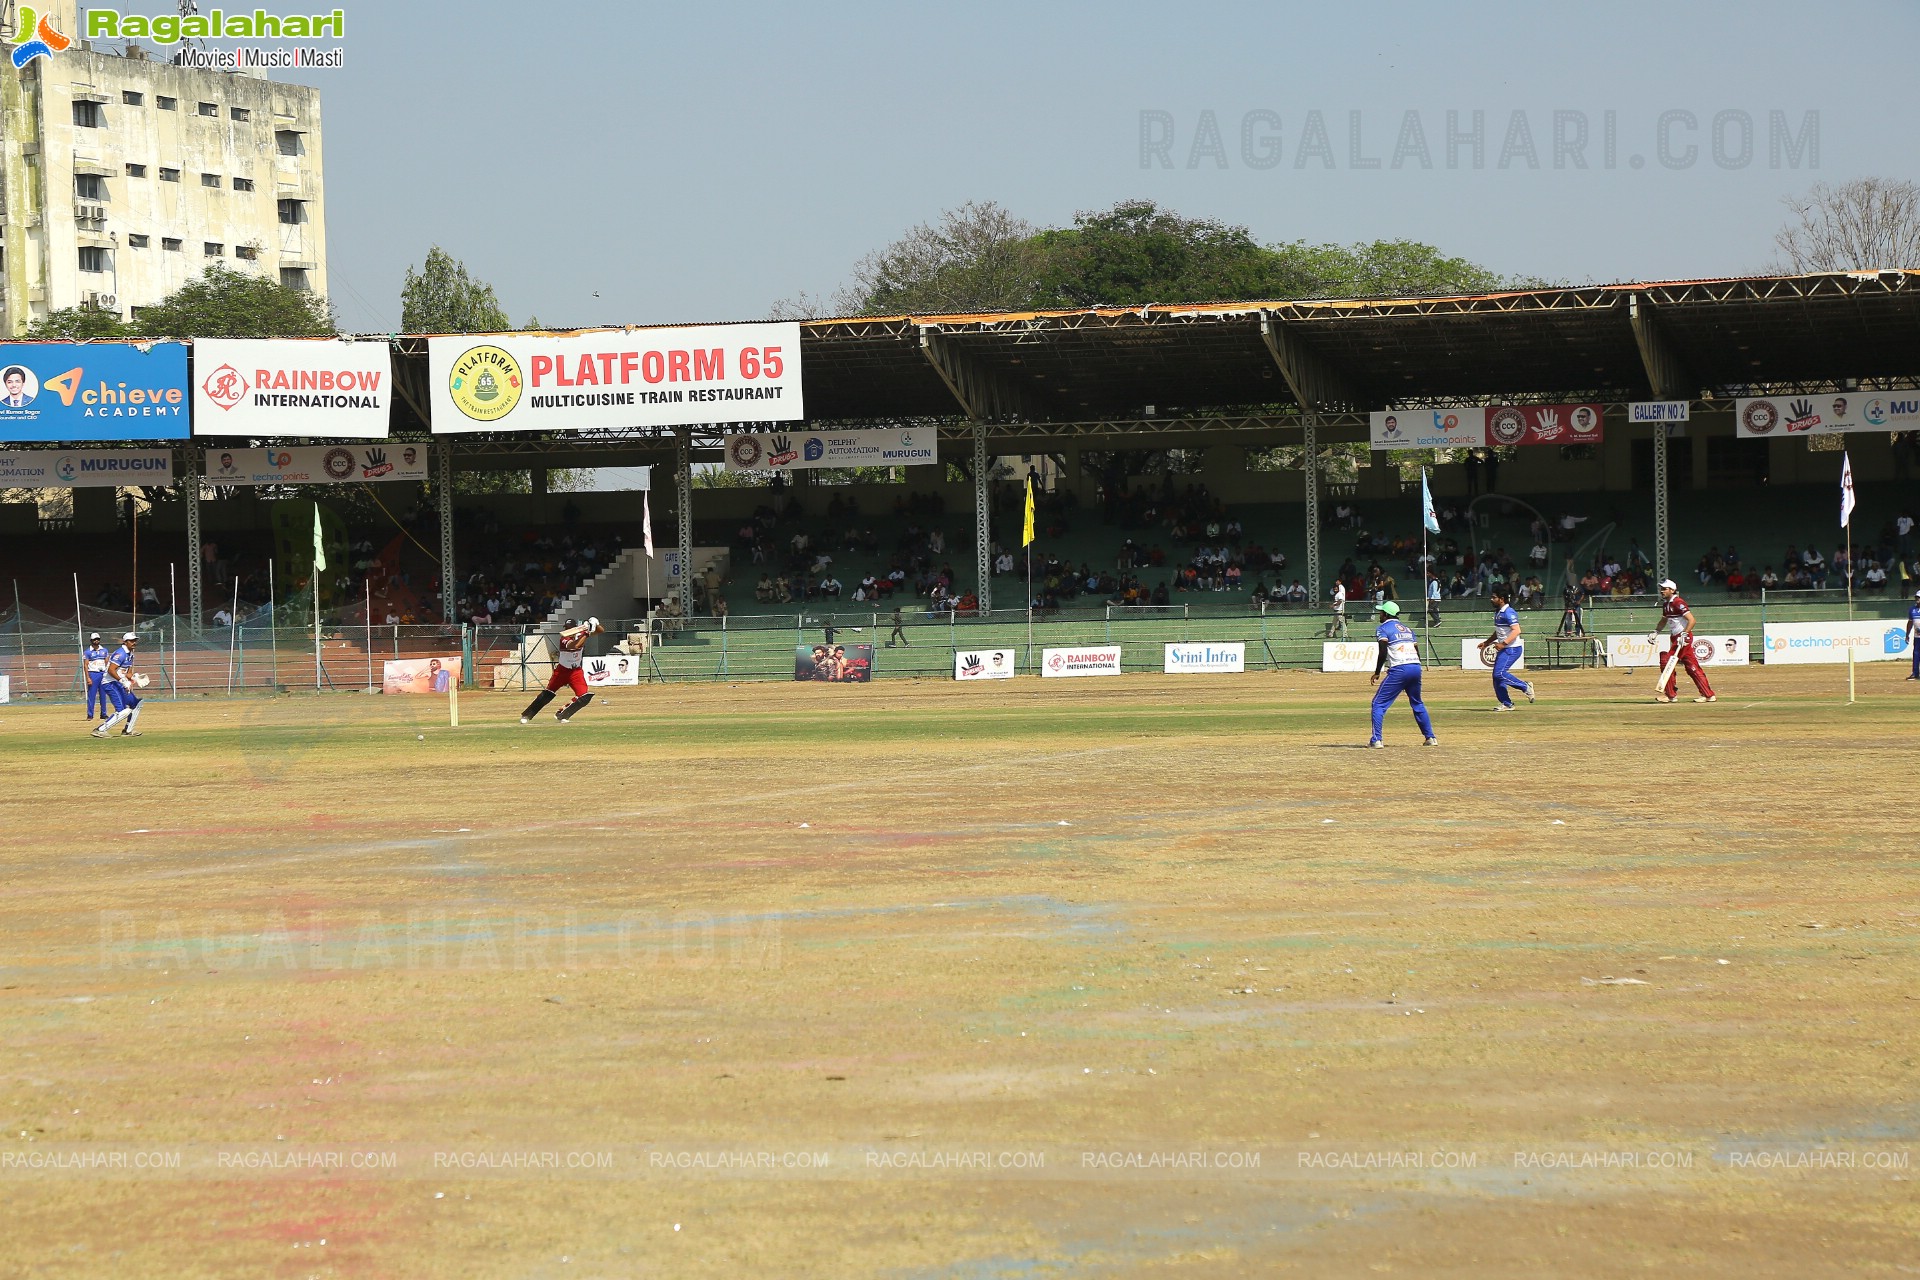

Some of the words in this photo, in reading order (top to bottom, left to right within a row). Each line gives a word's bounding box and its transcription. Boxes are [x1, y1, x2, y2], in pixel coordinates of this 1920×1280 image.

[458, 352, 514, 376] PLATFORM
[531, 347, 725, 388] PLATFORM
[739, 346, 784, 380] 65
[255, 369, 381, 391] RAINBOW
[480, 377, 492, 386] 65
[254, 393, 380, 408] INTERNATIONAL
[531, 392, 635, 409] MULTICUISINE
[639, 390, 683, 404] TRAIN
[688, 386, 783, 402] RESTAURANT
[84, 406, 181, 417] ACADEMY
[1634, 404, 1666, 420] GALLERY
[1667, 404, 1678, 419] NO
[1680, 404, 1685, 419] 2
[1501, 422, 1516, 430] CCC
[1666, 423, 1676, 435] 7
[1791, 416, 1818, 431] DRUGS
[1537, 425, 1564, 440] DRUGS
[828, 438, 857, 447] DELPHY
[1417, 435, 1476, 446] technopaints
[828, 446, 880, 455] AUTOMATION
[882, 449, 931, 459] MURUGUN
[80, 458, 167, 471] MURUGUN
[333, 460, 347, 468] CCC
[772, 452, 796, 465] DRUGS
[665, 553, 678, 562] GATE
[672, 563, 680, 576] 8
[1789, 635, 1870, 649] technopaints
[1067, 653, 1116, 663] RAINBOW
[1171, 647, 1202, 664] Srini
[1206, 647, 1237, 663] Infra
[1333, 643, 1375, 668] Barfi
[1066, 662, 1115, 670] INTERNATIONAL
